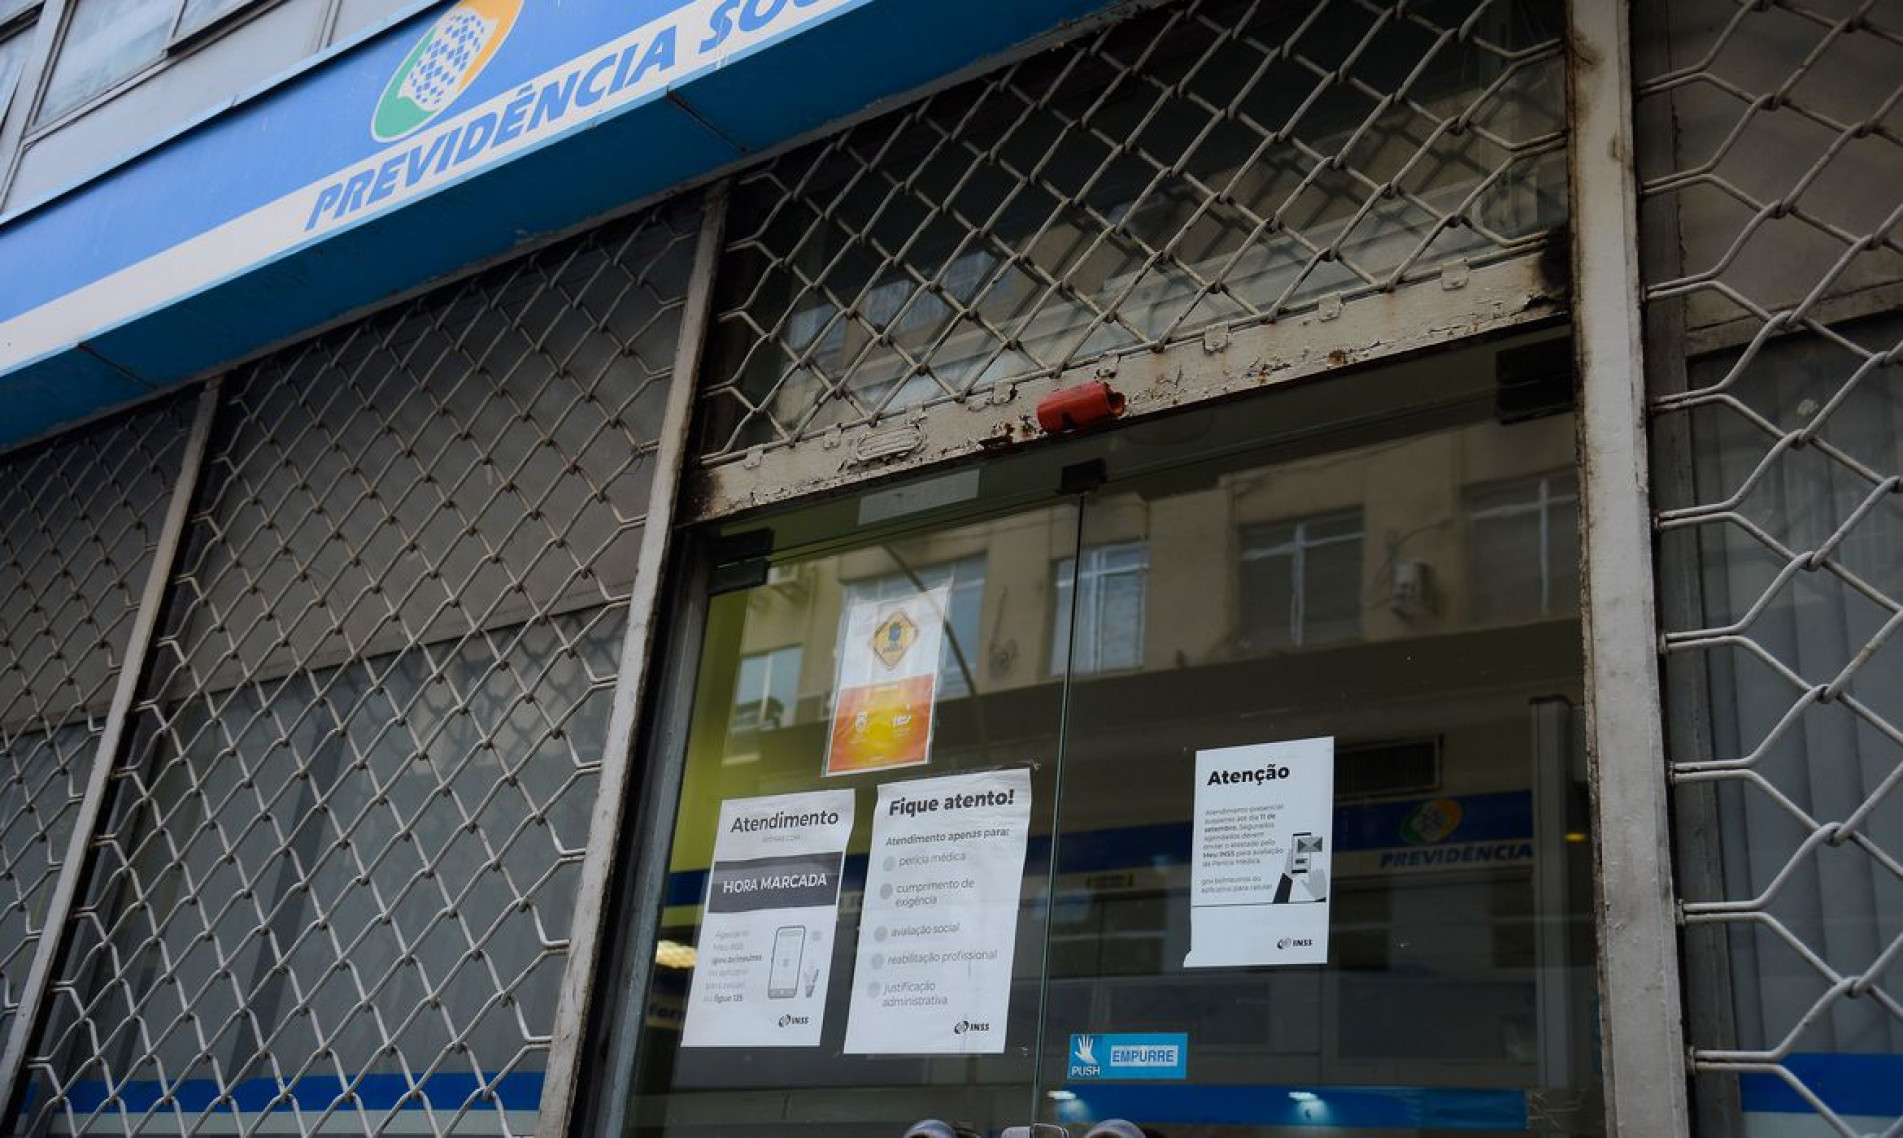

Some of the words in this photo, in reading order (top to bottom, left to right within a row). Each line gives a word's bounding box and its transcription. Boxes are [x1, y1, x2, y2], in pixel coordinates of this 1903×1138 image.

[304, 25, 677, 231] PREVIDÊNCIA
[698, 0, 817, 54] SO
[1207, 764, 1290, 786] Atenção
[889, 797, 939, 818] Fique
[944, 789, 1015, 811] atento!
[730, 810, 839, 833] Atendimento
[886, 833, 946, 846] Atendimento
[948, 830, 982, 842] apenas
[930, 851, 966, 863] médica
[723, 879, 758, 894] HORA
[761, 872, 827, 891] MARCADA
[896, 880, 960, 894] cumprimento
[961, 878, 975, 889] de
[934, 922, 960, 934] social
[1293, 939, 1313, 947] INSS
[888, 951, 941, 966] reabilitação
[941, 949, 997, 964] profissional
[791, 1016, 809, 1025] INSS
[969, 1022, 989, 1032] INSS
[1112, 1049, 1175, 1062] EMPURRE
[1071, 1065, 1101, 1077] PUSH
